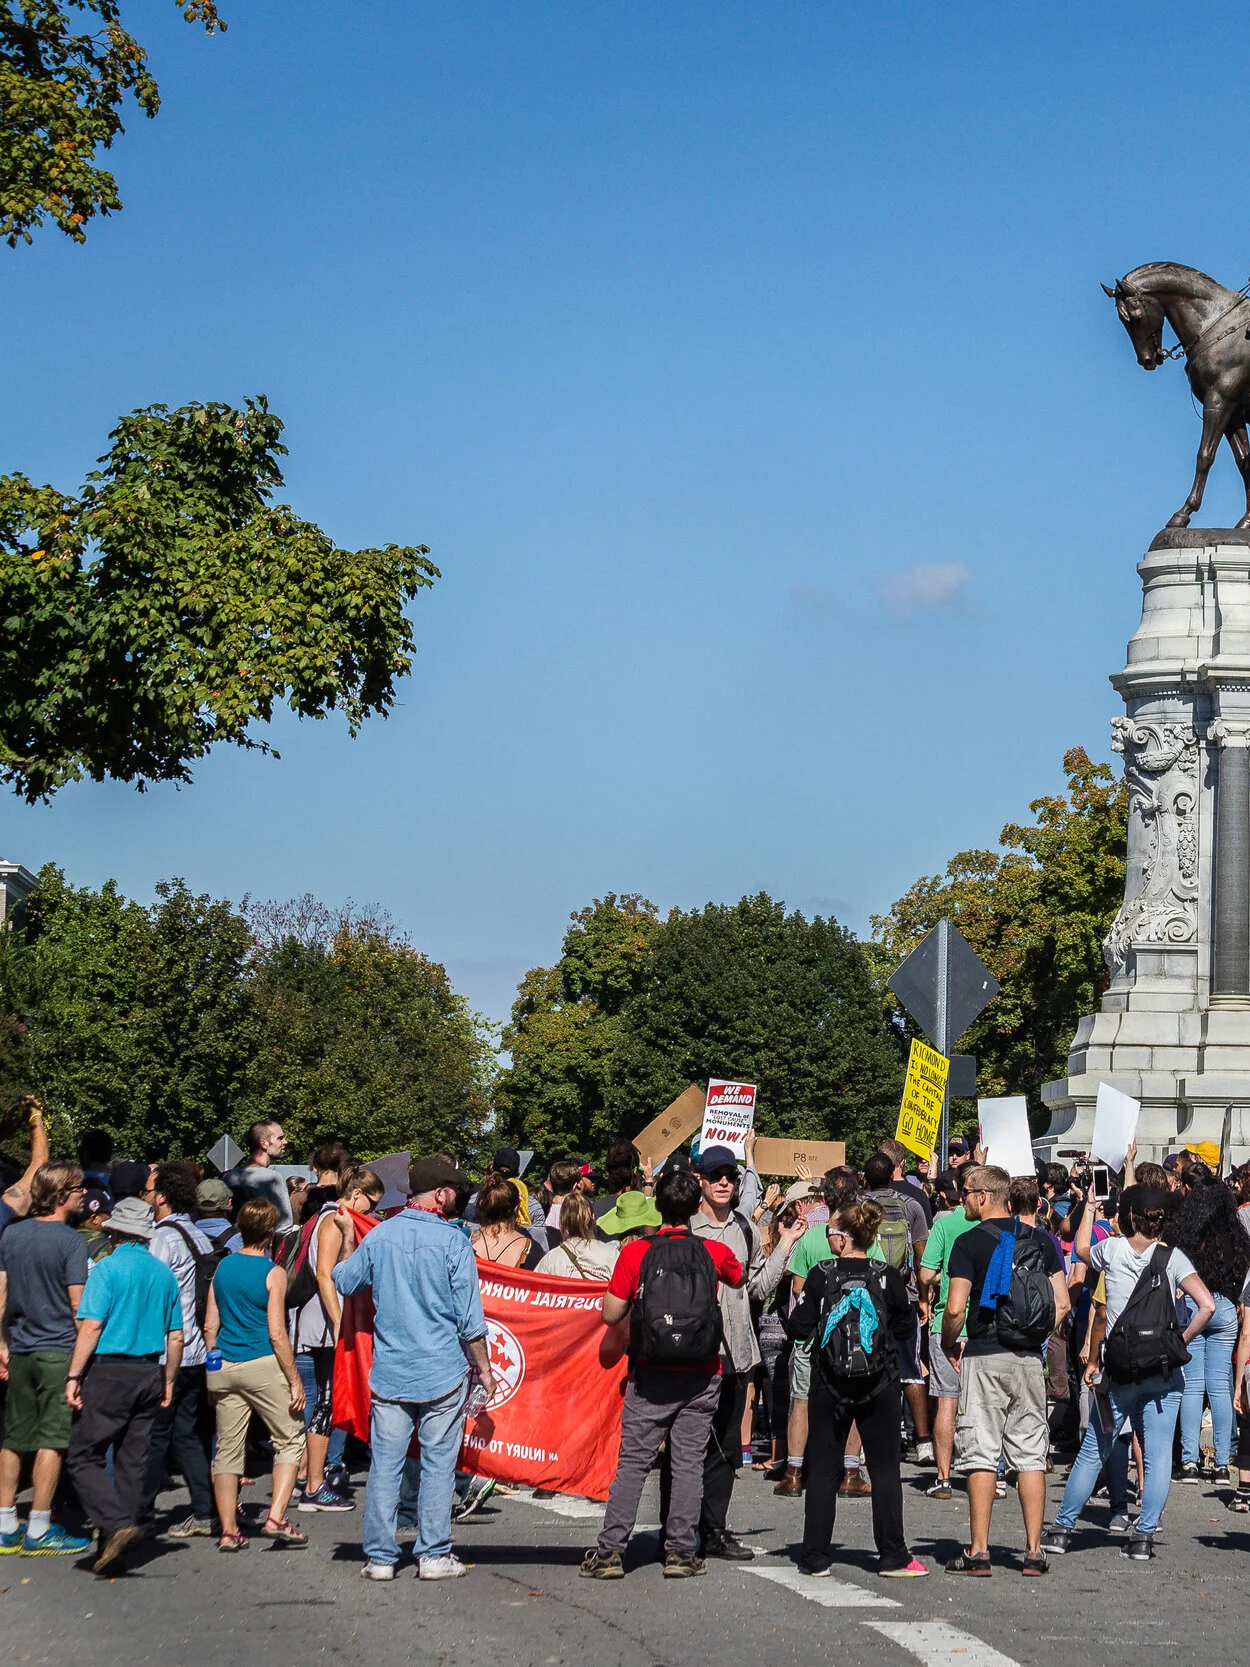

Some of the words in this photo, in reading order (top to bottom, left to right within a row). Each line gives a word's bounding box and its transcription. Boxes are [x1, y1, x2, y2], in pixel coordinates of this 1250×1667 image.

[920, 1063, 928, 1075] NO
[723, 1086, 742, 1094] WE
[909, 1073, 920, 1087] THE
[922, 1082, 943, 1104] CAPITAL
[710, 1095, 752, 1104] DEMAND
[912, 1089, 920, 1099] OF
[922, 1095, 935, 1111] THE
[709, 1109, 741, 1119] REMOVAL
[705, 1118, 750, 1129] MONUMENTS
[902, 1112, 914, 1130] GO
[915, 1121, 935, 1145] HOME
[705, 1127, 749, 1144] NOW!
[793, 1152, 806, 1162] P8
